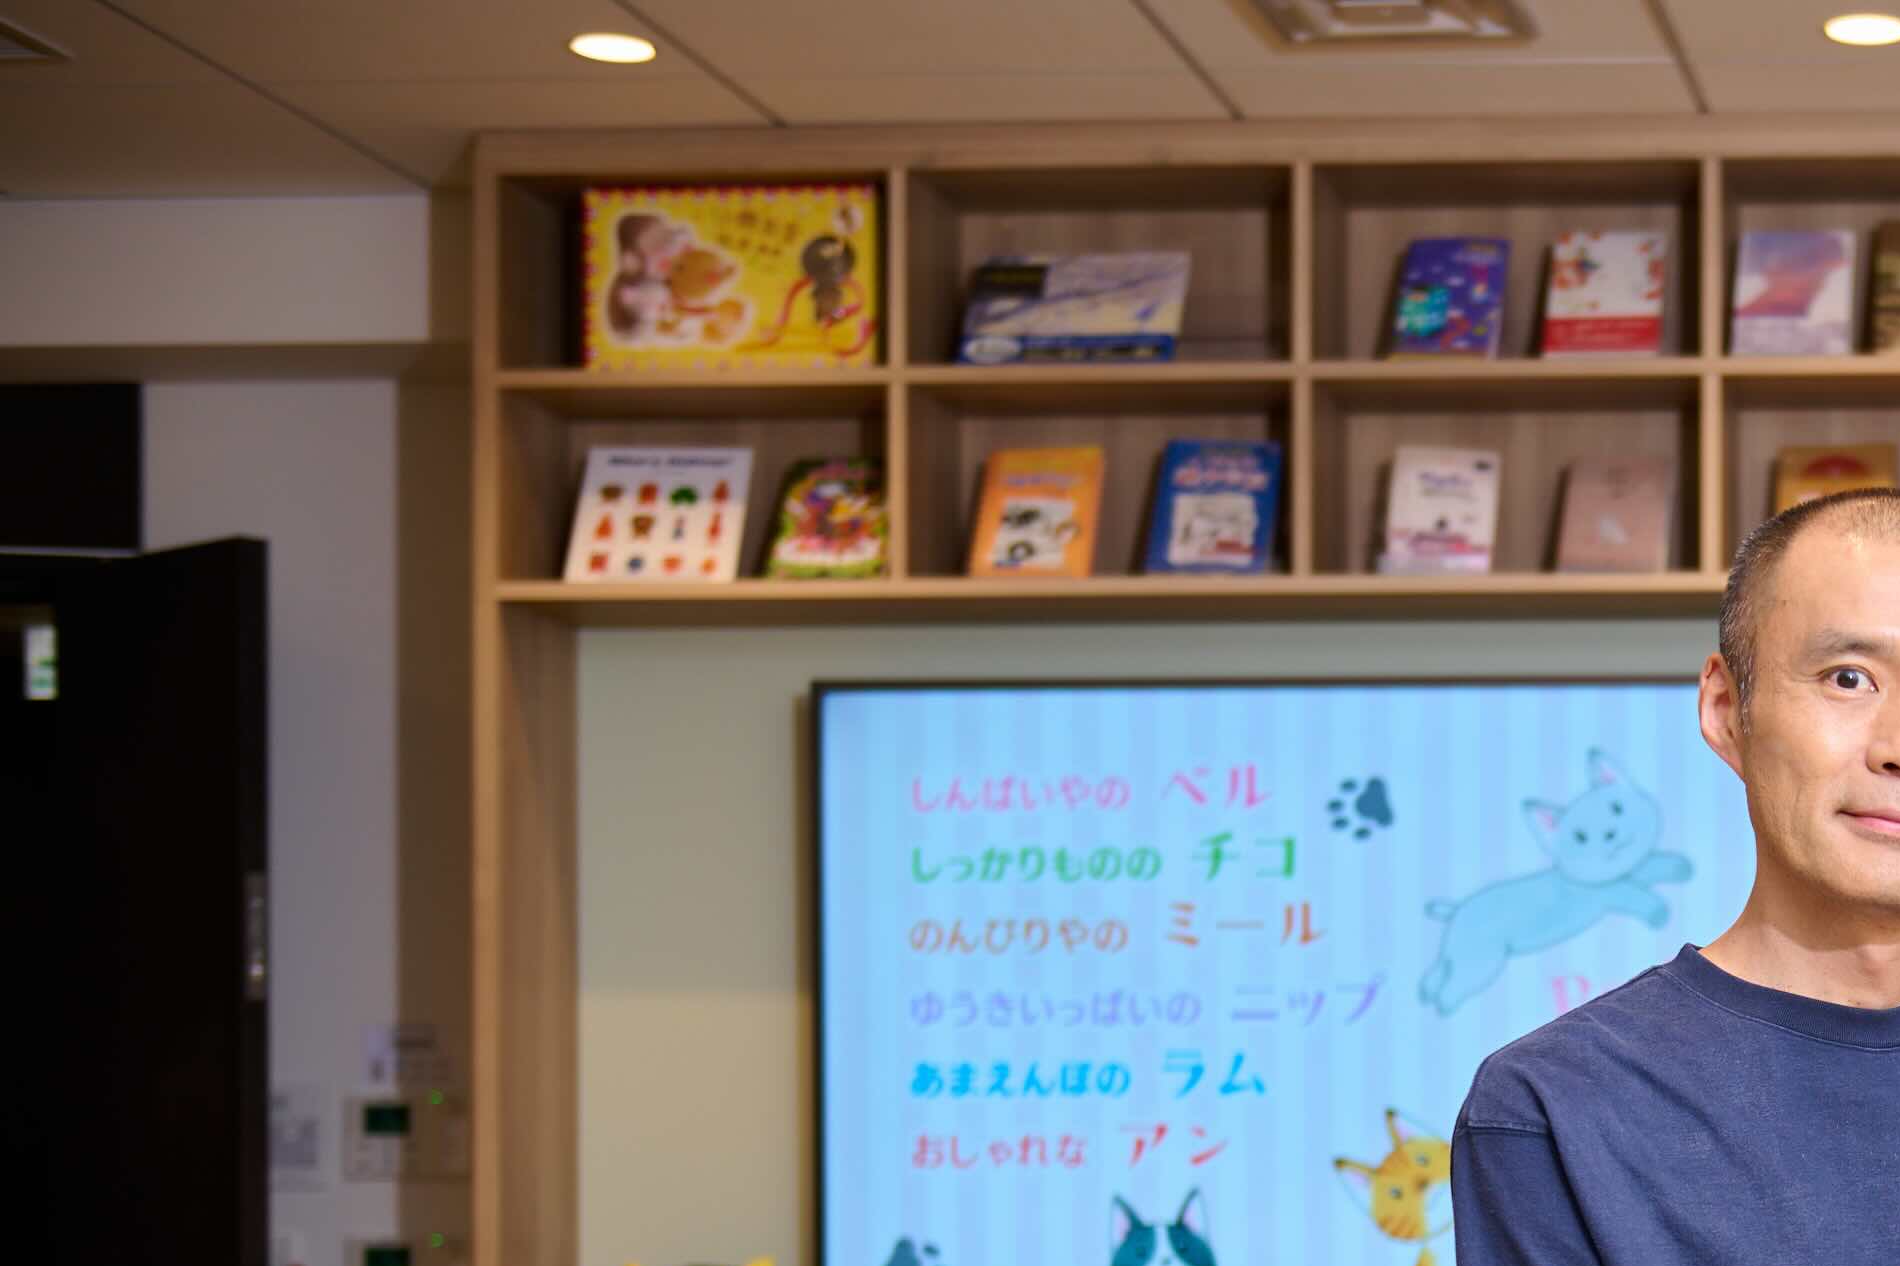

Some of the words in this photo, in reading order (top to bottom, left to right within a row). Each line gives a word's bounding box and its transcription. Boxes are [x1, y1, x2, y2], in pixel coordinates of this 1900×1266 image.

[1160, 763, 1272, 809] ベル
[911, 846, 1164, 884] しっかりものの
[1191, 831, 1298, 881] チコ
[909, 915, 1130, 954] のんびりやの
[1165, 900, 1328, 949] ミール
[1162, 1049, 1267, 1100] ラム
[912, 1132, 1091, 1170] おしゃれな
[1117, 1121, 1231, 1169] アン
